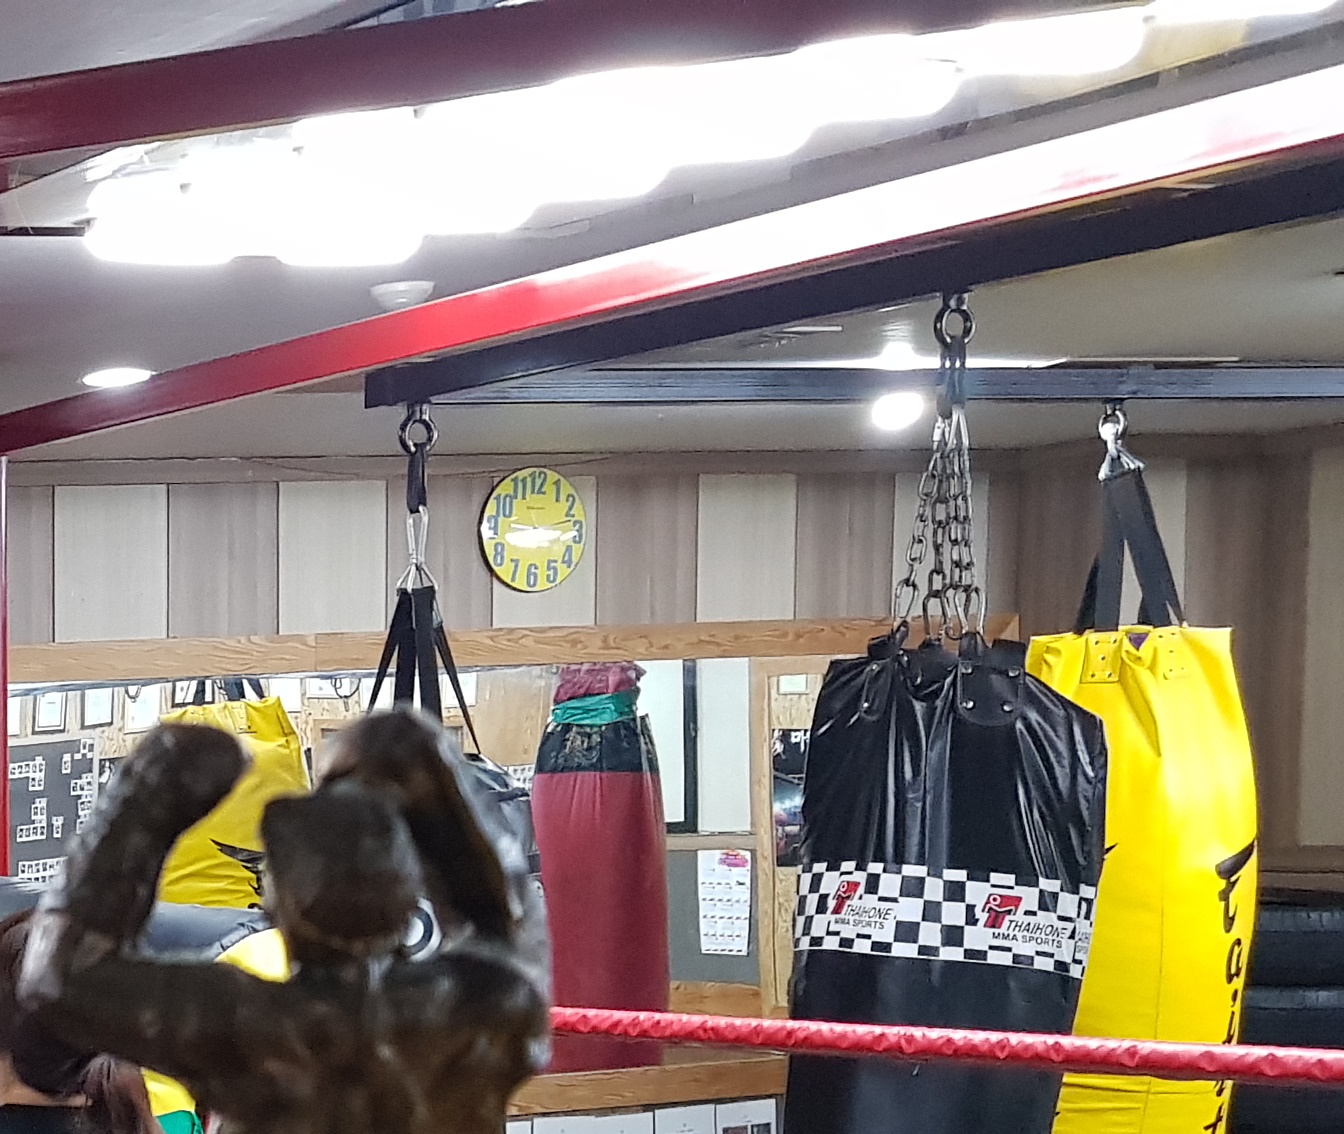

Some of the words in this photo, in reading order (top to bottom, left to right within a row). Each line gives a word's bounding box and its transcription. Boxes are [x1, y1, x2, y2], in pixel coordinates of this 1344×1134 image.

[511, 476, 527, 500] 11
[529, 470, 547, 495] 12
[552, 479, 561, 502] 1
[494, 494, 513, 518] 10
[565, 493, 576, 518] 2
[487, 515, 499, 539] 9
[572, 519, 583, 544] 3
[493, 542, 505, 567] 8
[561, 545, 573, 569] 4
[510, 558, 520, 583] 7
[526, 563, 539, 588] 6
[546, 559, 559, 584] 5
[844, 903, 894, 920] THAIHONE
[852, 919, 885, 930] SPORTS
[1006, 919, 1068, 939] THAIHONE
[992, 931, 1019, 943] MMA
[1021, 934, 1063, 949] SPORTS
